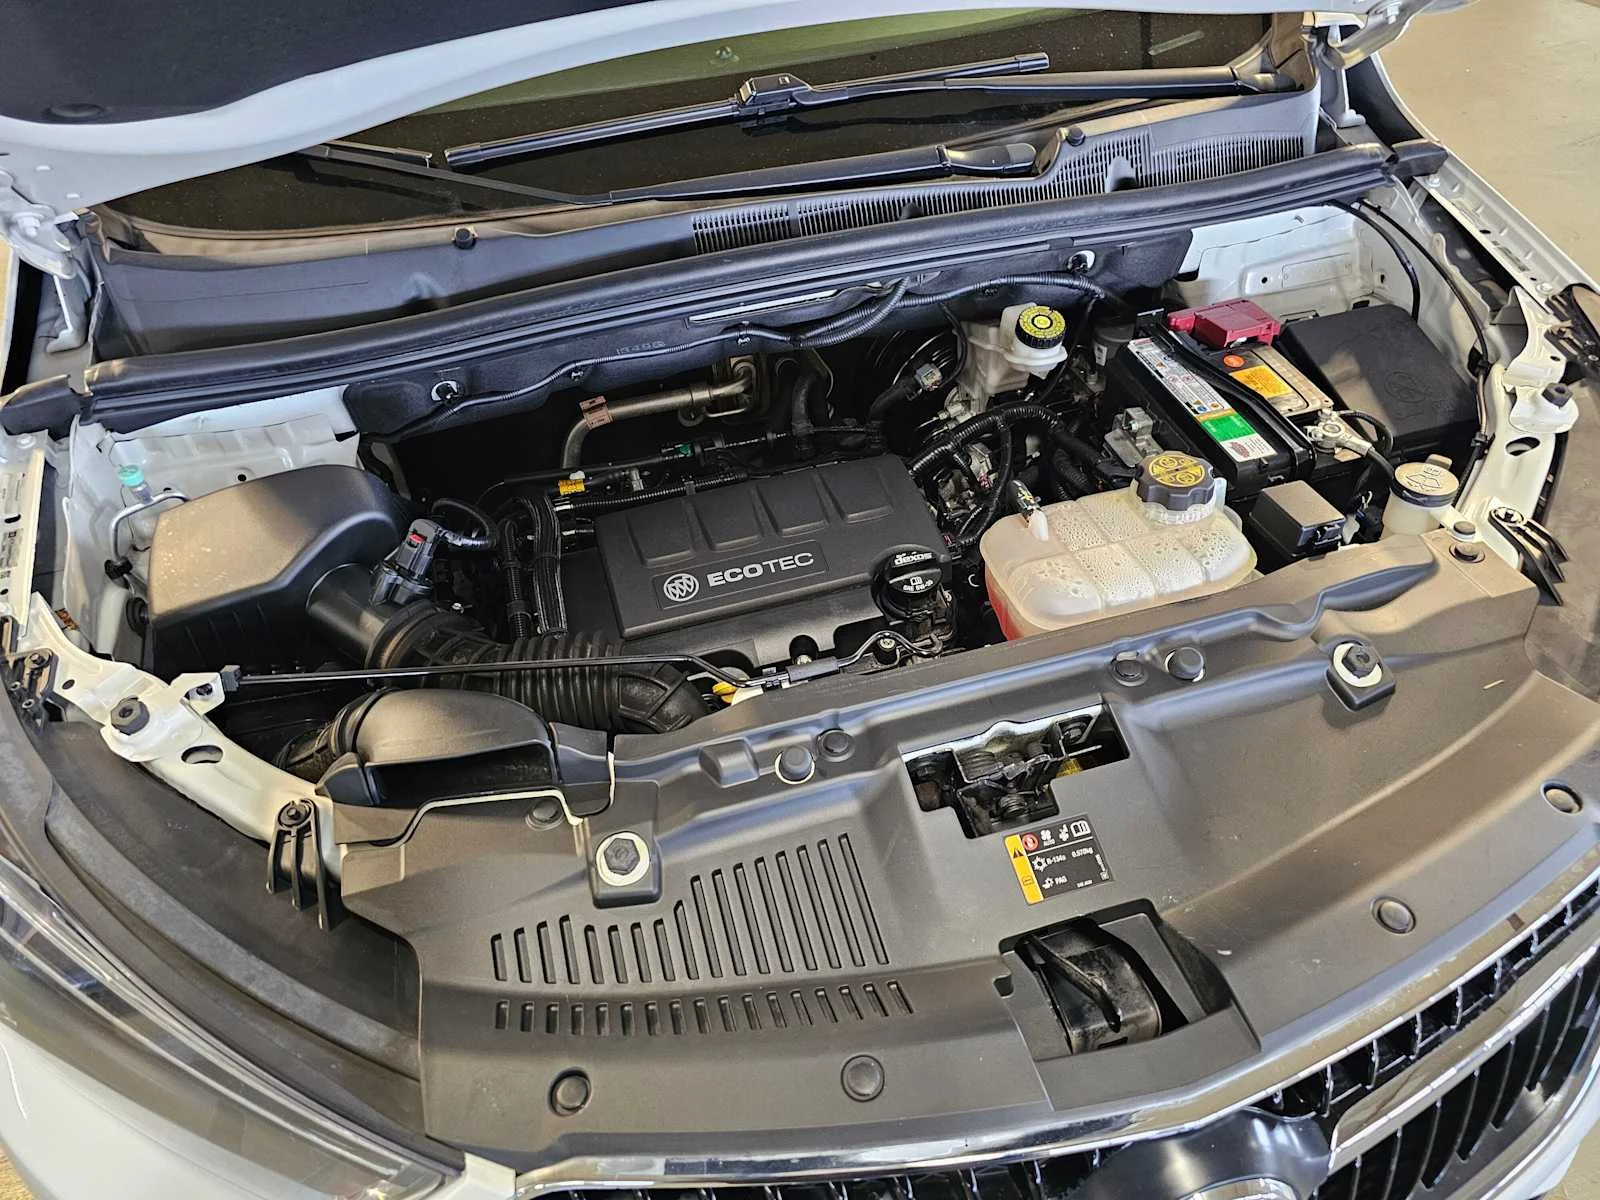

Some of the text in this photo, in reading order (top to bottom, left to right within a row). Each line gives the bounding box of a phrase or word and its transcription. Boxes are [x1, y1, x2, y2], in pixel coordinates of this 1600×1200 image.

[894, 553, 933, 565] dexos
[707, 552, 814, 587] ECOTEC
[1054, 875, 1068, 885] PAG
